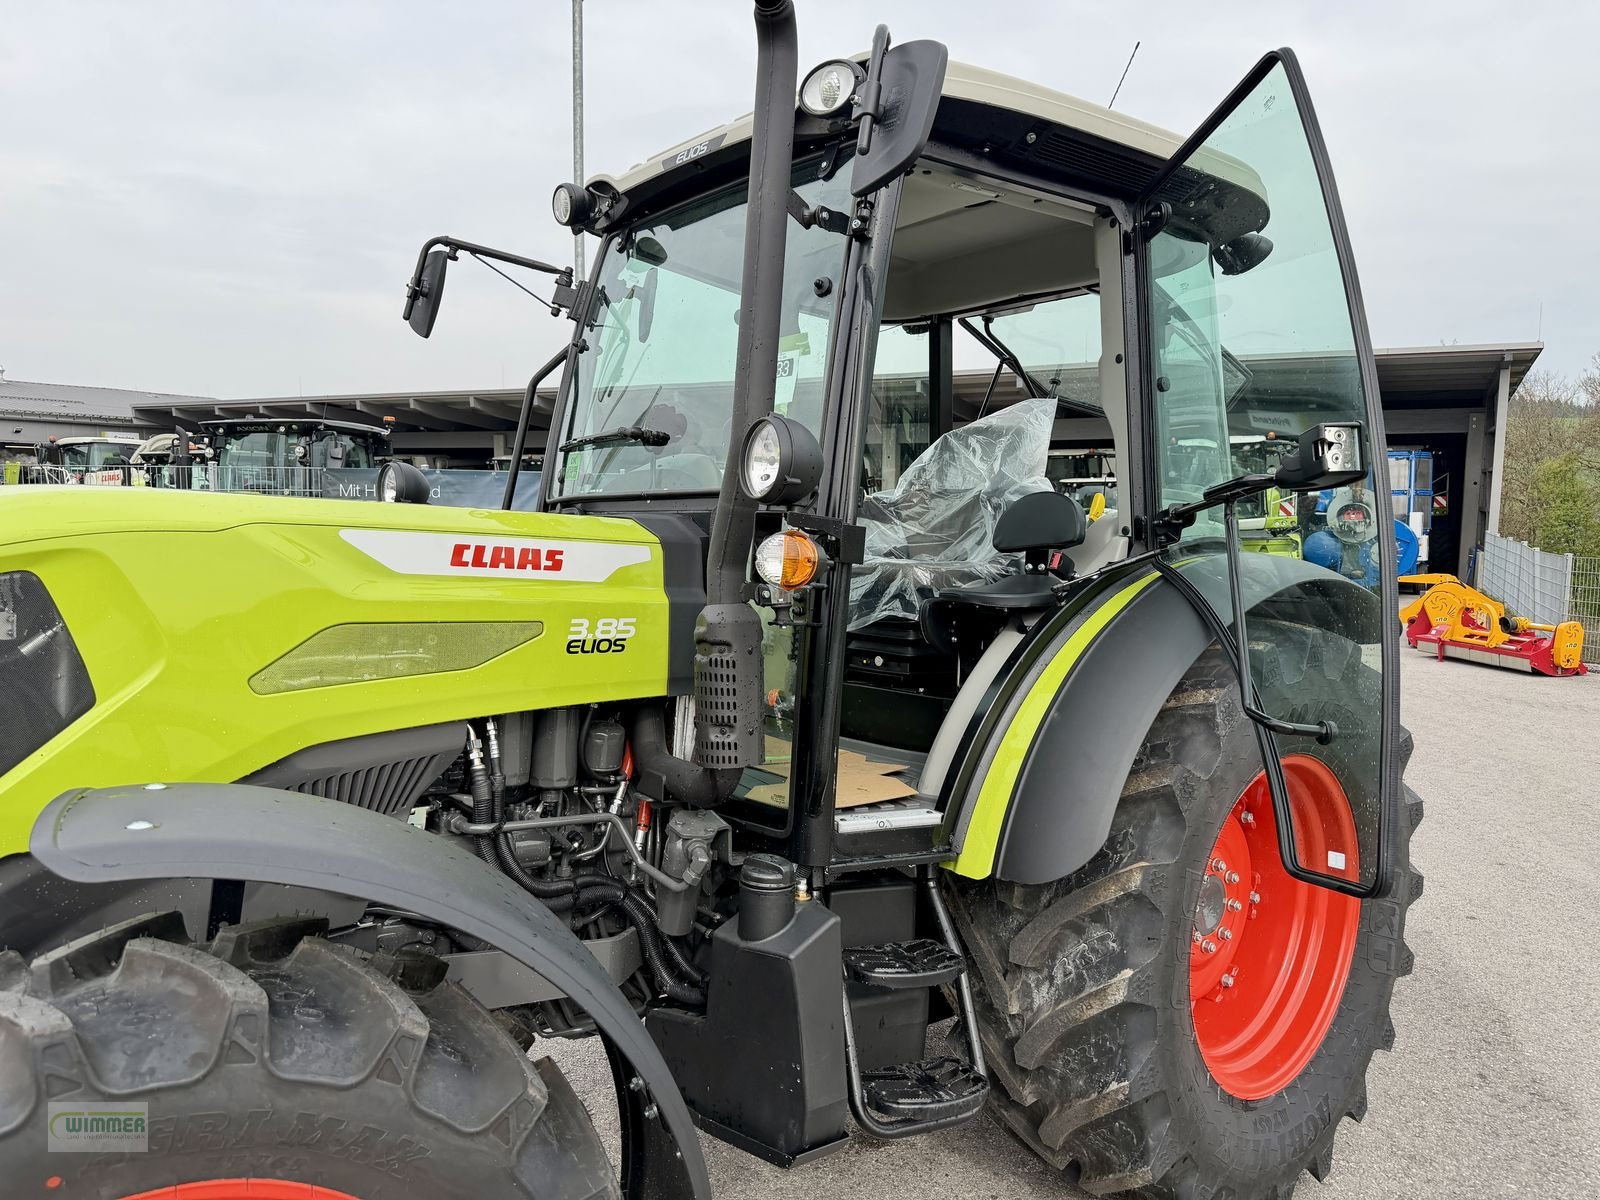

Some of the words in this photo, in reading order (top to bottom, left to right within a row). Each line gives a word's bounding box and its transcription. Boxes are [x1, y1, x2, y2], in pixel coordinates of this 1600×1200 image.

[676, 141, 709, 164] ELIOS
[101, 473, 121, 482] CLAAS
[339, 484, 361, 497] Mit
[450, 543, 564, 572] CLAAS
[568, 617, 637, 640] 3.85
[566, 637, 628, 655] ELIOS
